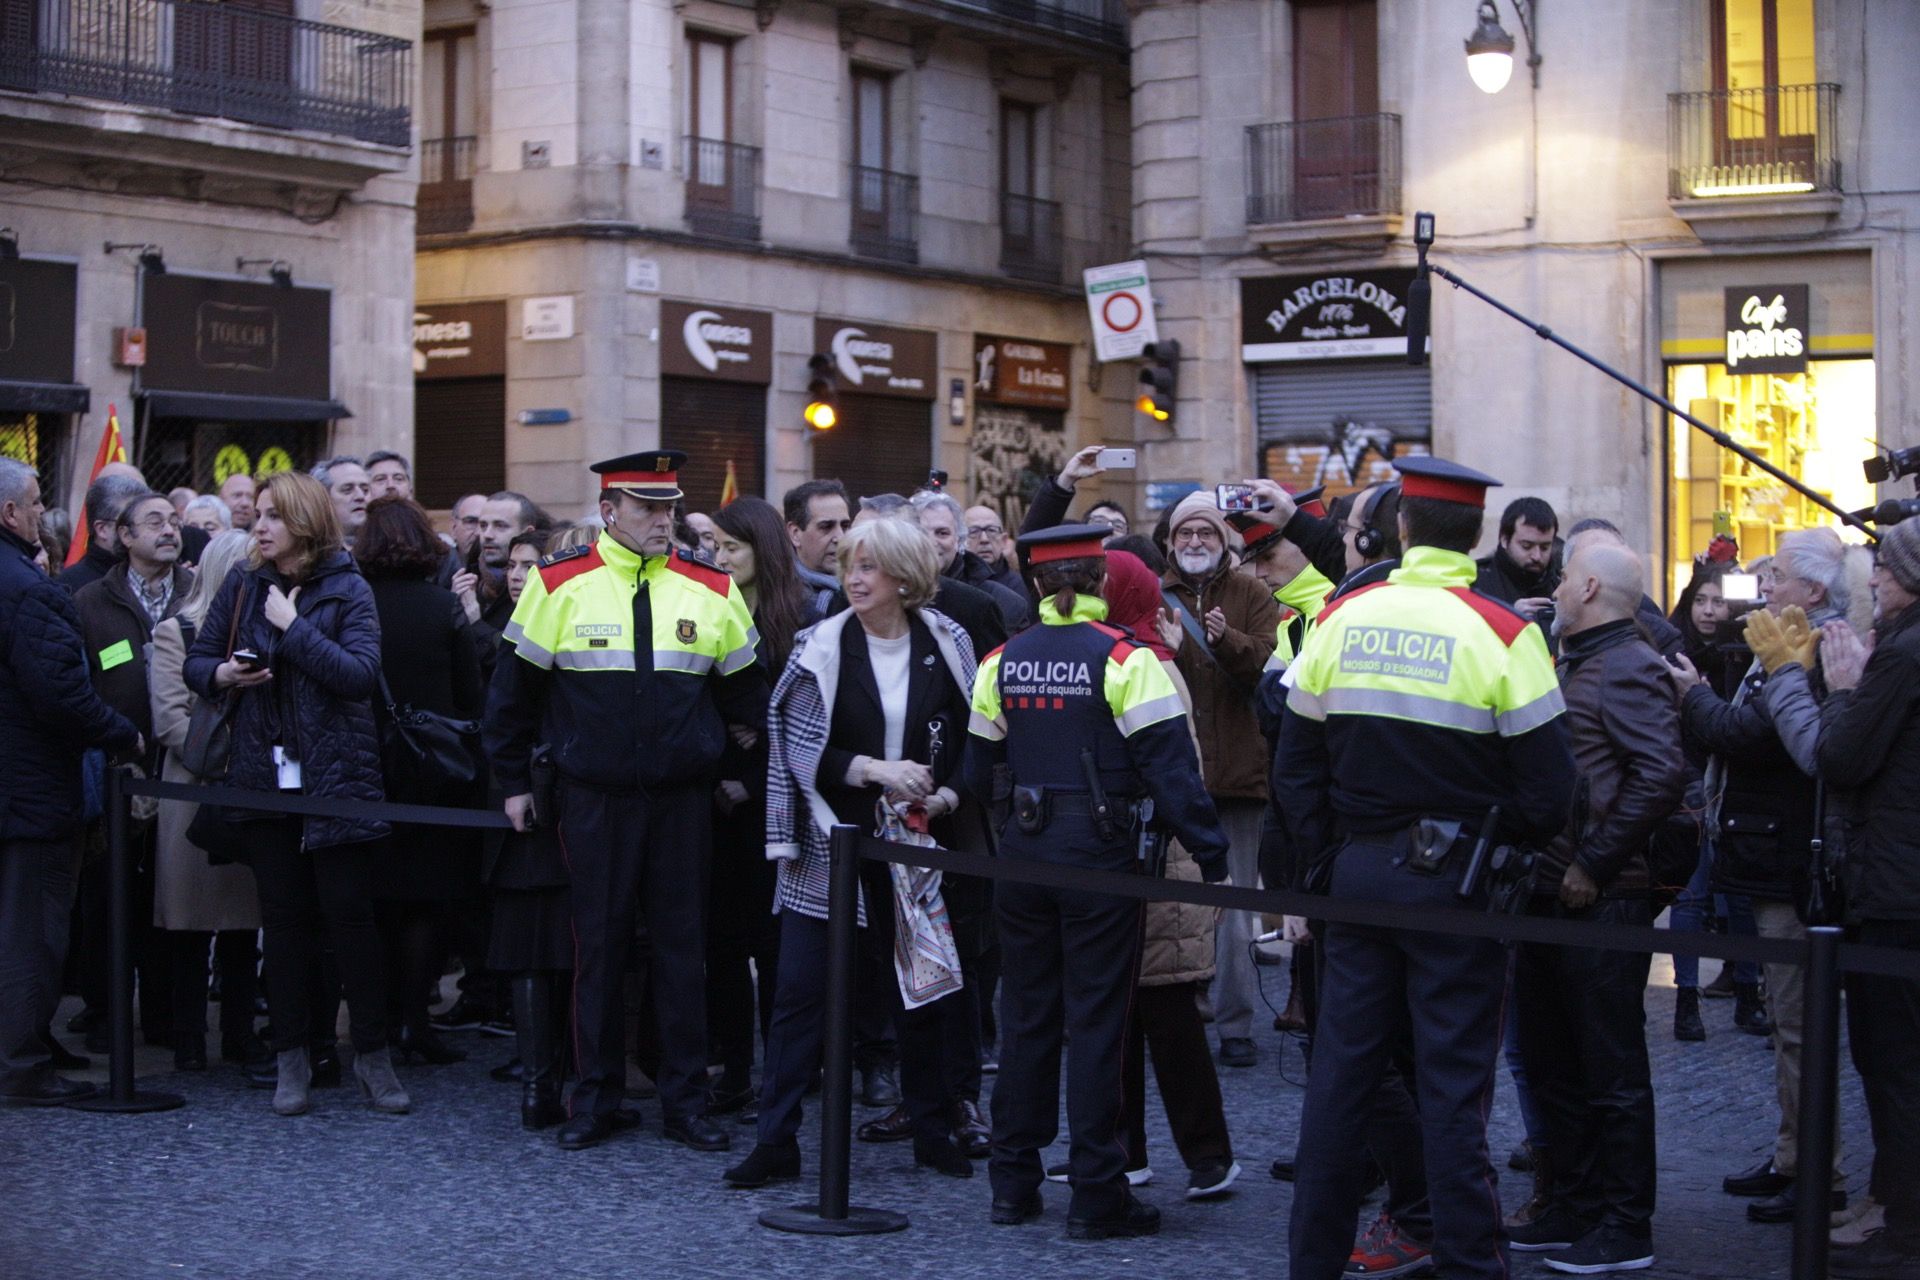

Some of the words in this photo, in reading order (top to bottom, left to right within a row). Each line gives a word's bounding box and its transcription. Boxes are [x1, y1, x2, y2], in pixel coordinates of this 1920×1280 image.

[1265, 277, 1407, 334] BARCELONA
[1727, 328, 1804, 367] pans
[577, 625, 619, 636] POLICIA
[1344, 629, 1448, 665] POLICIA
[1003, 661, 1092, 684] POLICIA
[1343, 660, 1380, 671] MOSSOS
[1383, 662, 1444, 681] D'ESQUADRA
[1003, 684, 1036, 695] mossos
